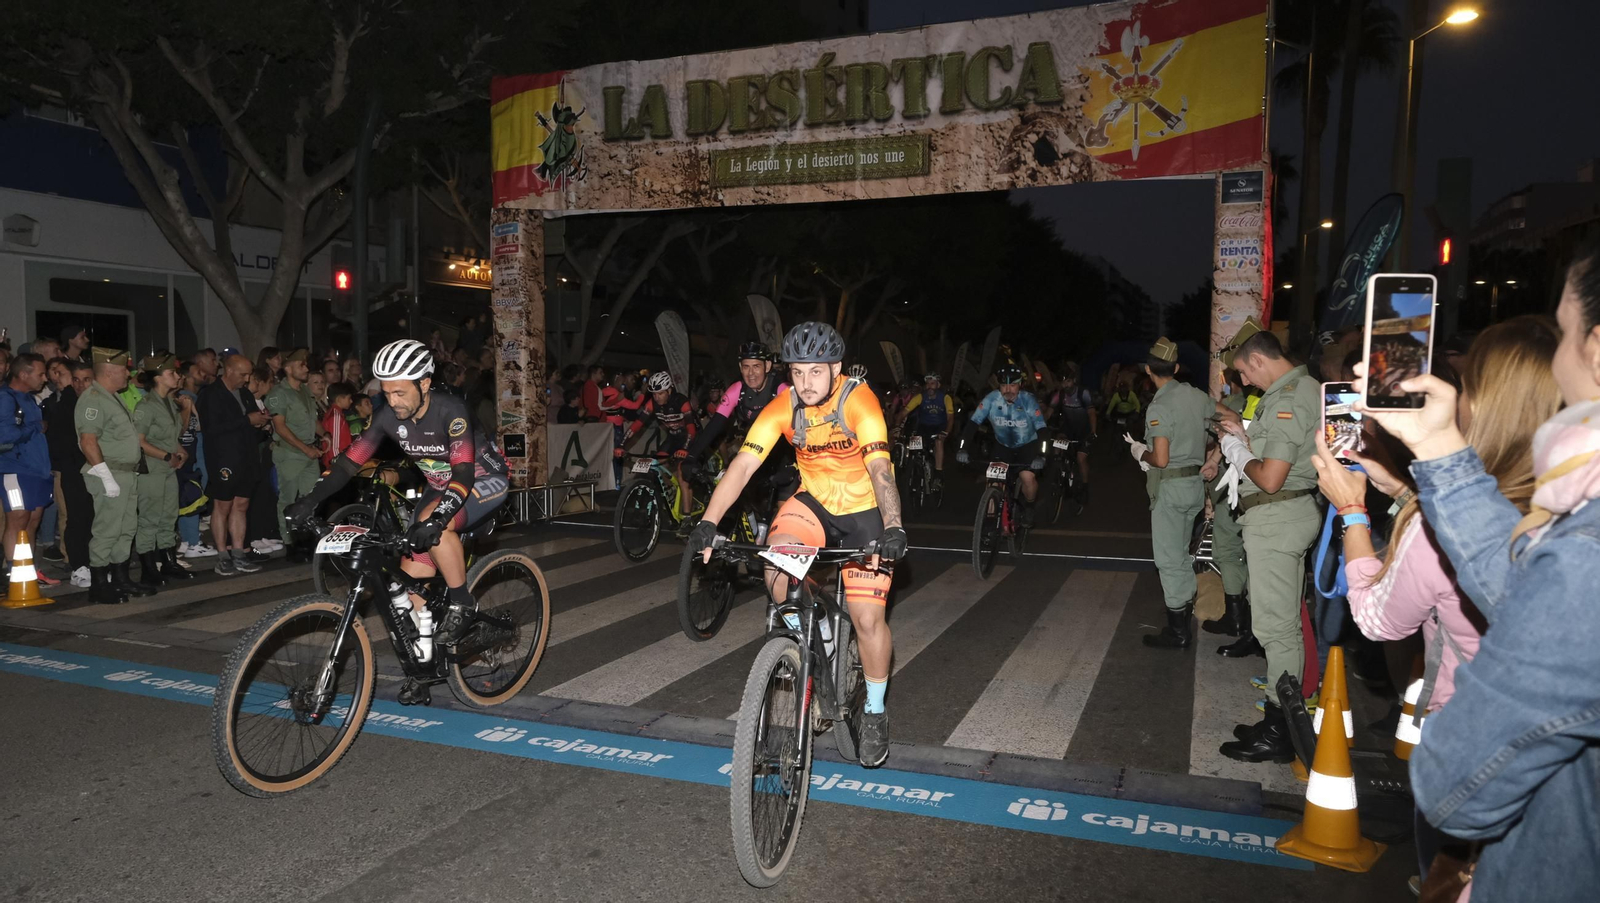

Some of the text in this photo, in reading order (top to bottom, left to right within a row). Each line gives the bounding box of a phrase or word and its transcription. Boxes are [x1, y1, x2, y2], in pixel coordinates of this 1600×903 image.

[602, 40, 1065, 141] LA DESÉRTICA
[730, 151, 905, 174] La Legión y el desierto nos une
[1220, 246, 1259, 256] RENTA
[527, 736, 675, 763] cajamar
[585, 753, 657, 768] CAJA RURAL
[809, 773, 955, 803] ajamar
[856, 791, 943, 808] CAJA RURAL
[1179, 836, 1223, 847] CAJA
